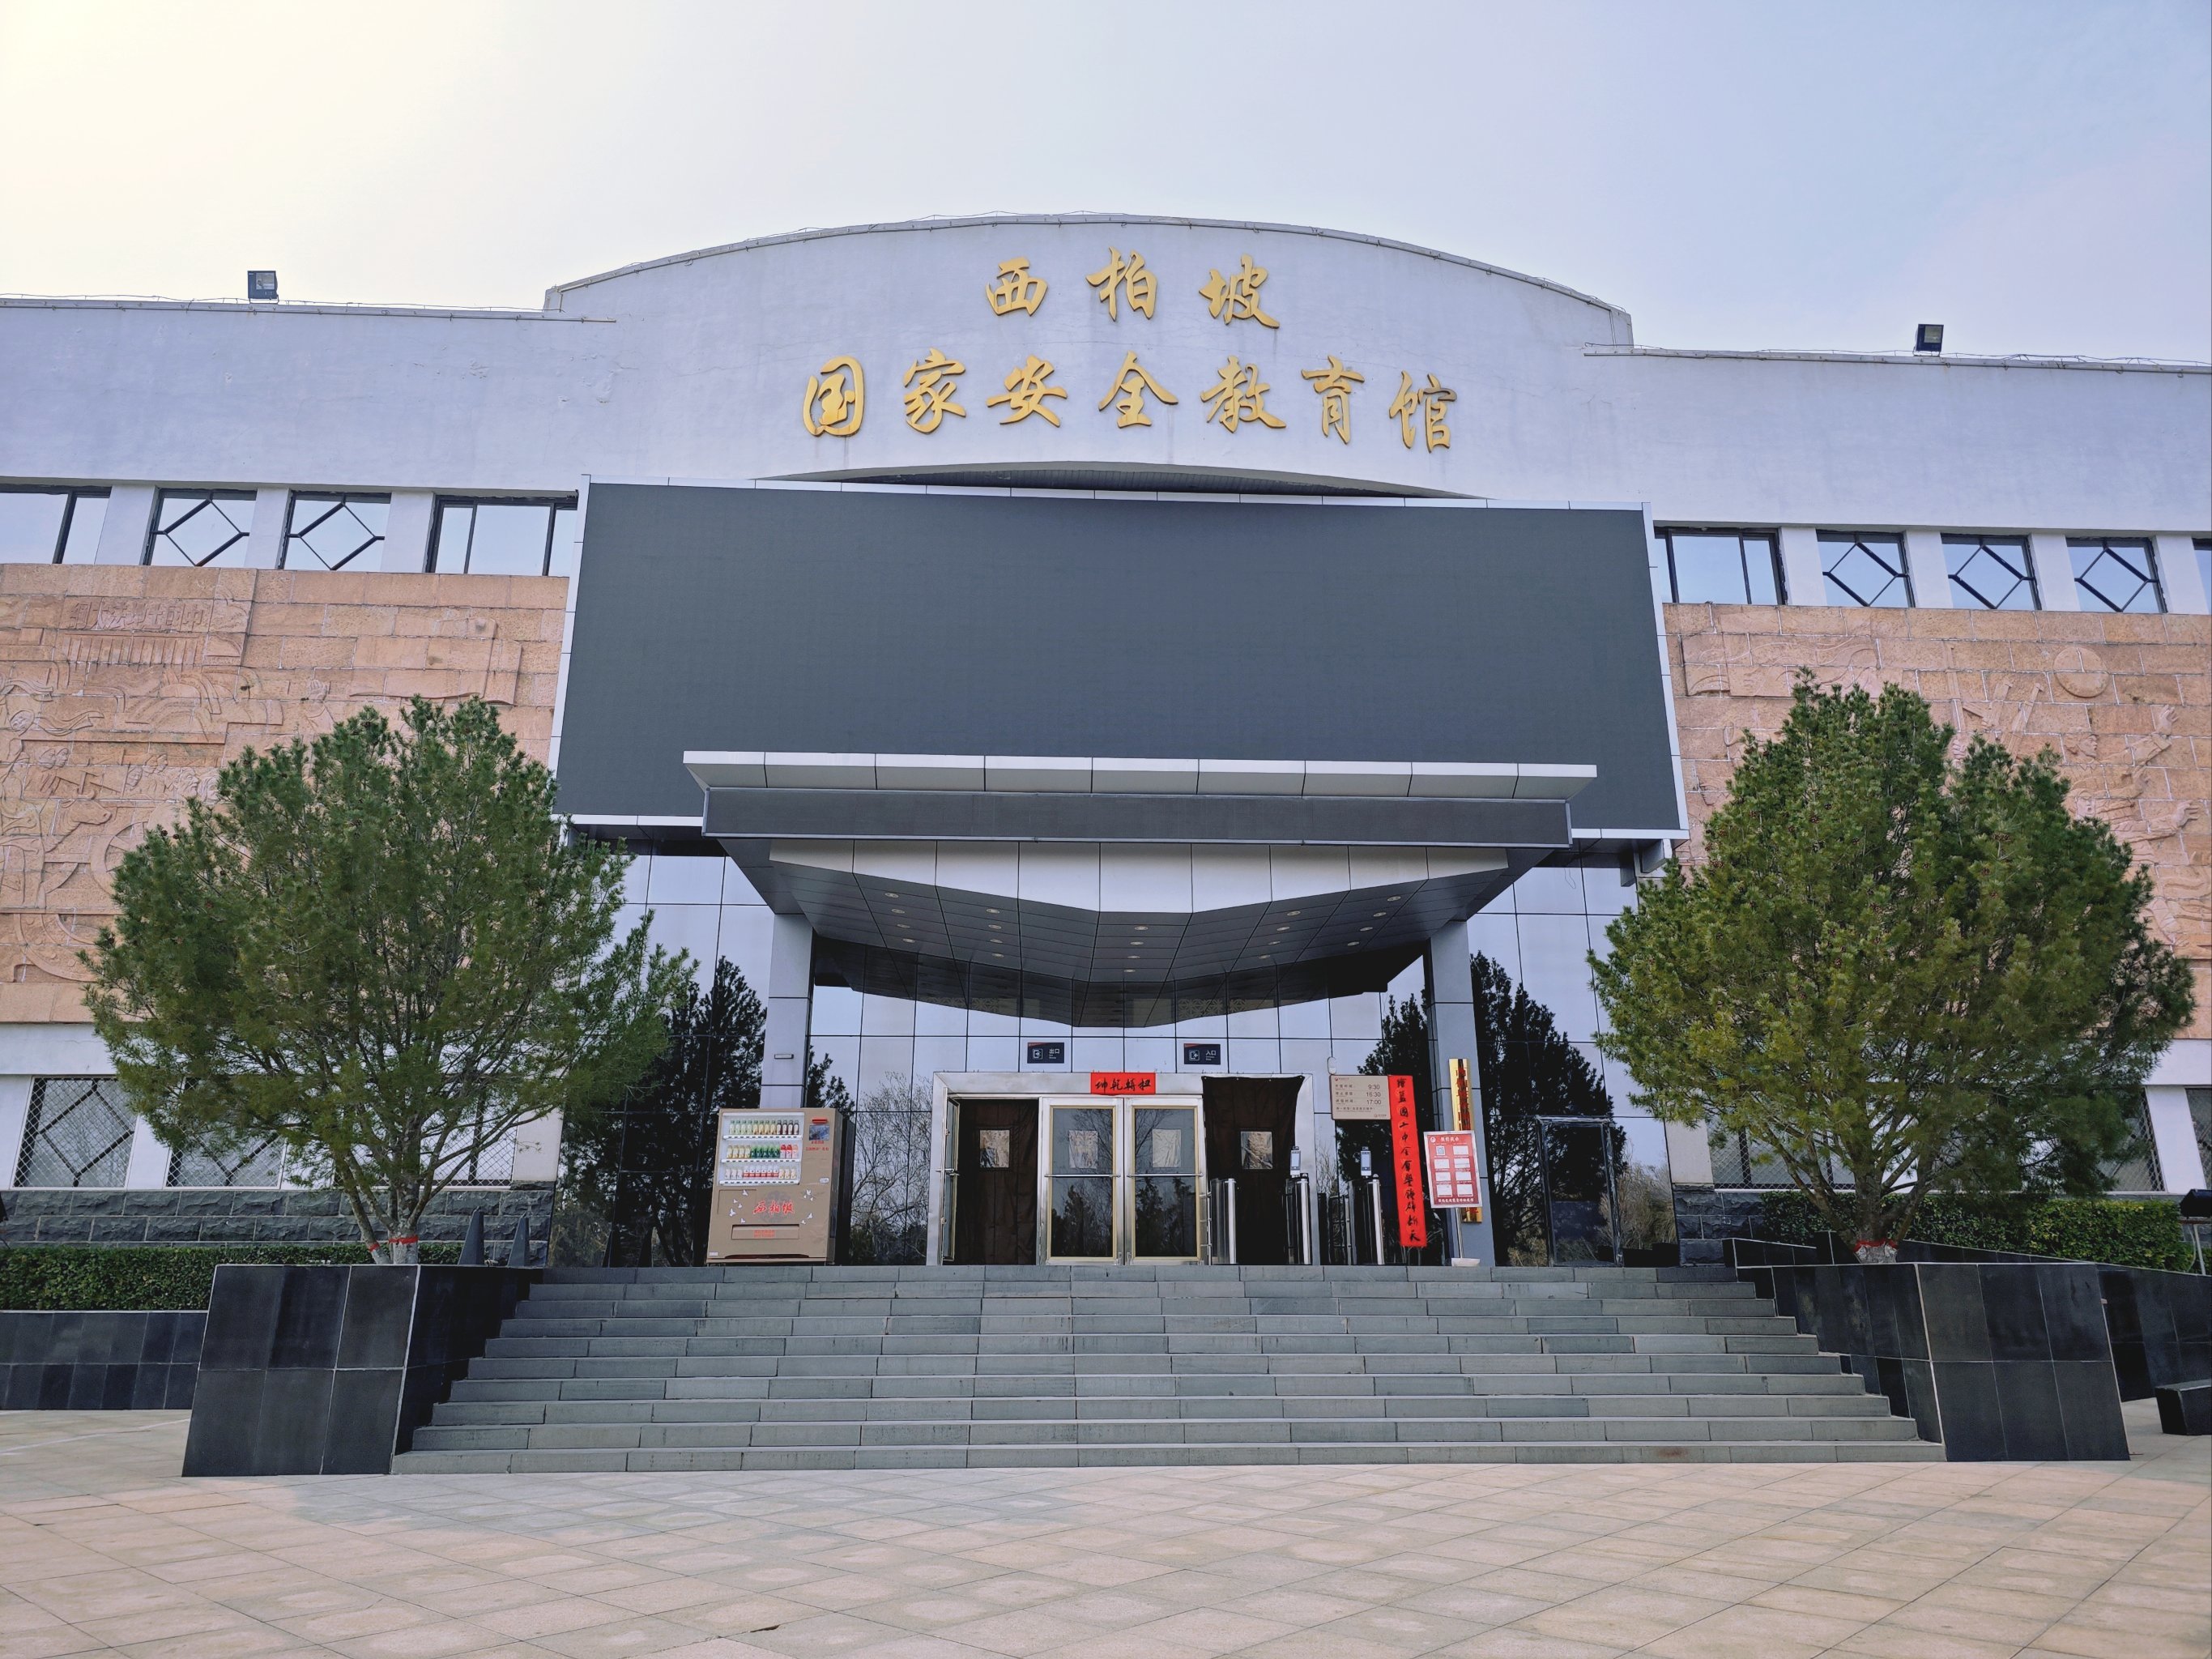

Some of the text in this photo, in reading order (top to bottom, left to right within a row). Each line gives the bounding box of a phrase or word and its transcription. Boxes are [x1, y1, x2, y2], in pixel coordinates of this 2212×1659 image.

[985, 246, 1281, 329] 西柏坡
[803, 348, 1457, 454] 国家安全教育馆
